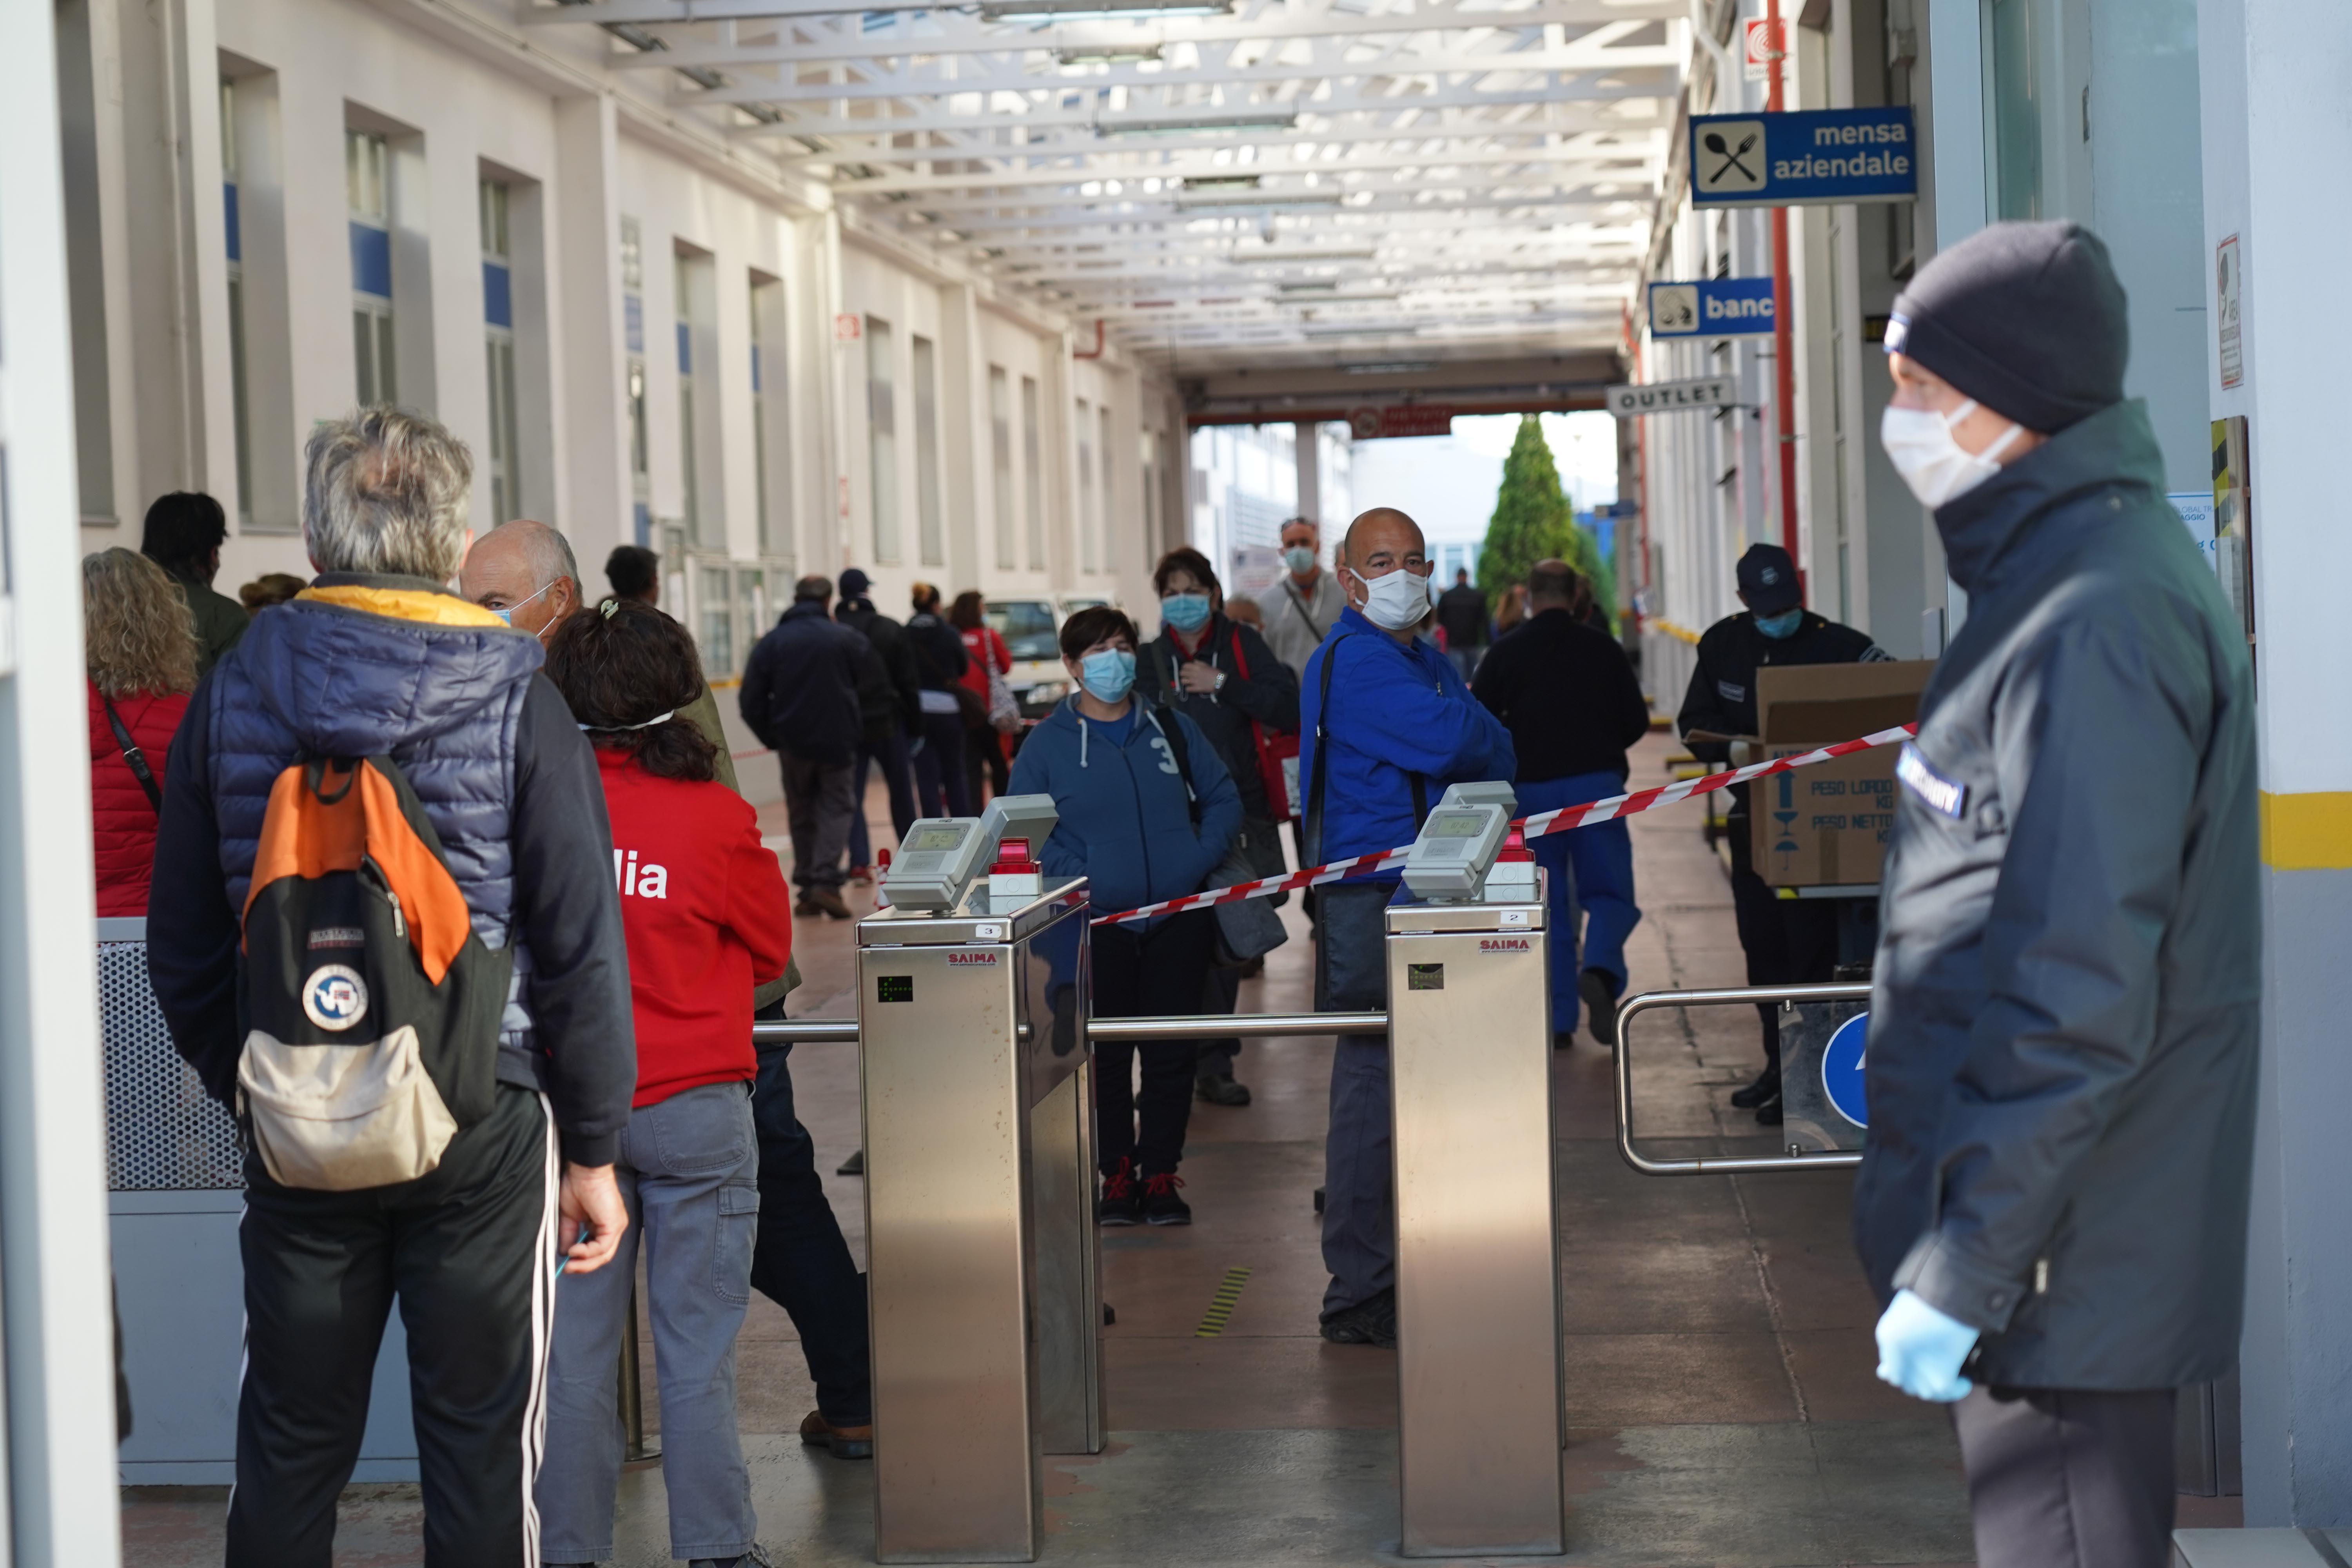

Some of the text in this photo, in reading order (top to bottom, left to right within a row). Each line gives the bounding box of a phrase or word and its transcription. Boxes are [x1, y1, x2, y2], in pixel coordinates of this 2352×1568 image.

[1815, 123, 1907, 146] mensa
[1774, 150, 1909, 179] aziendale
[1706, 295, 1775, 319] banc
[1620, 384, 1722, 408] OUTLET
[1150, 737, 1179, 774] 3
[1811, 780, 1845, 796] PESO
[1877, 795, 1893, 809] KG
[1812, 813, 1894, 830] PESO NETTO
[1480, 940, 1529, 949] SAIMA
[948, 953, 996, 963] SAIMA
